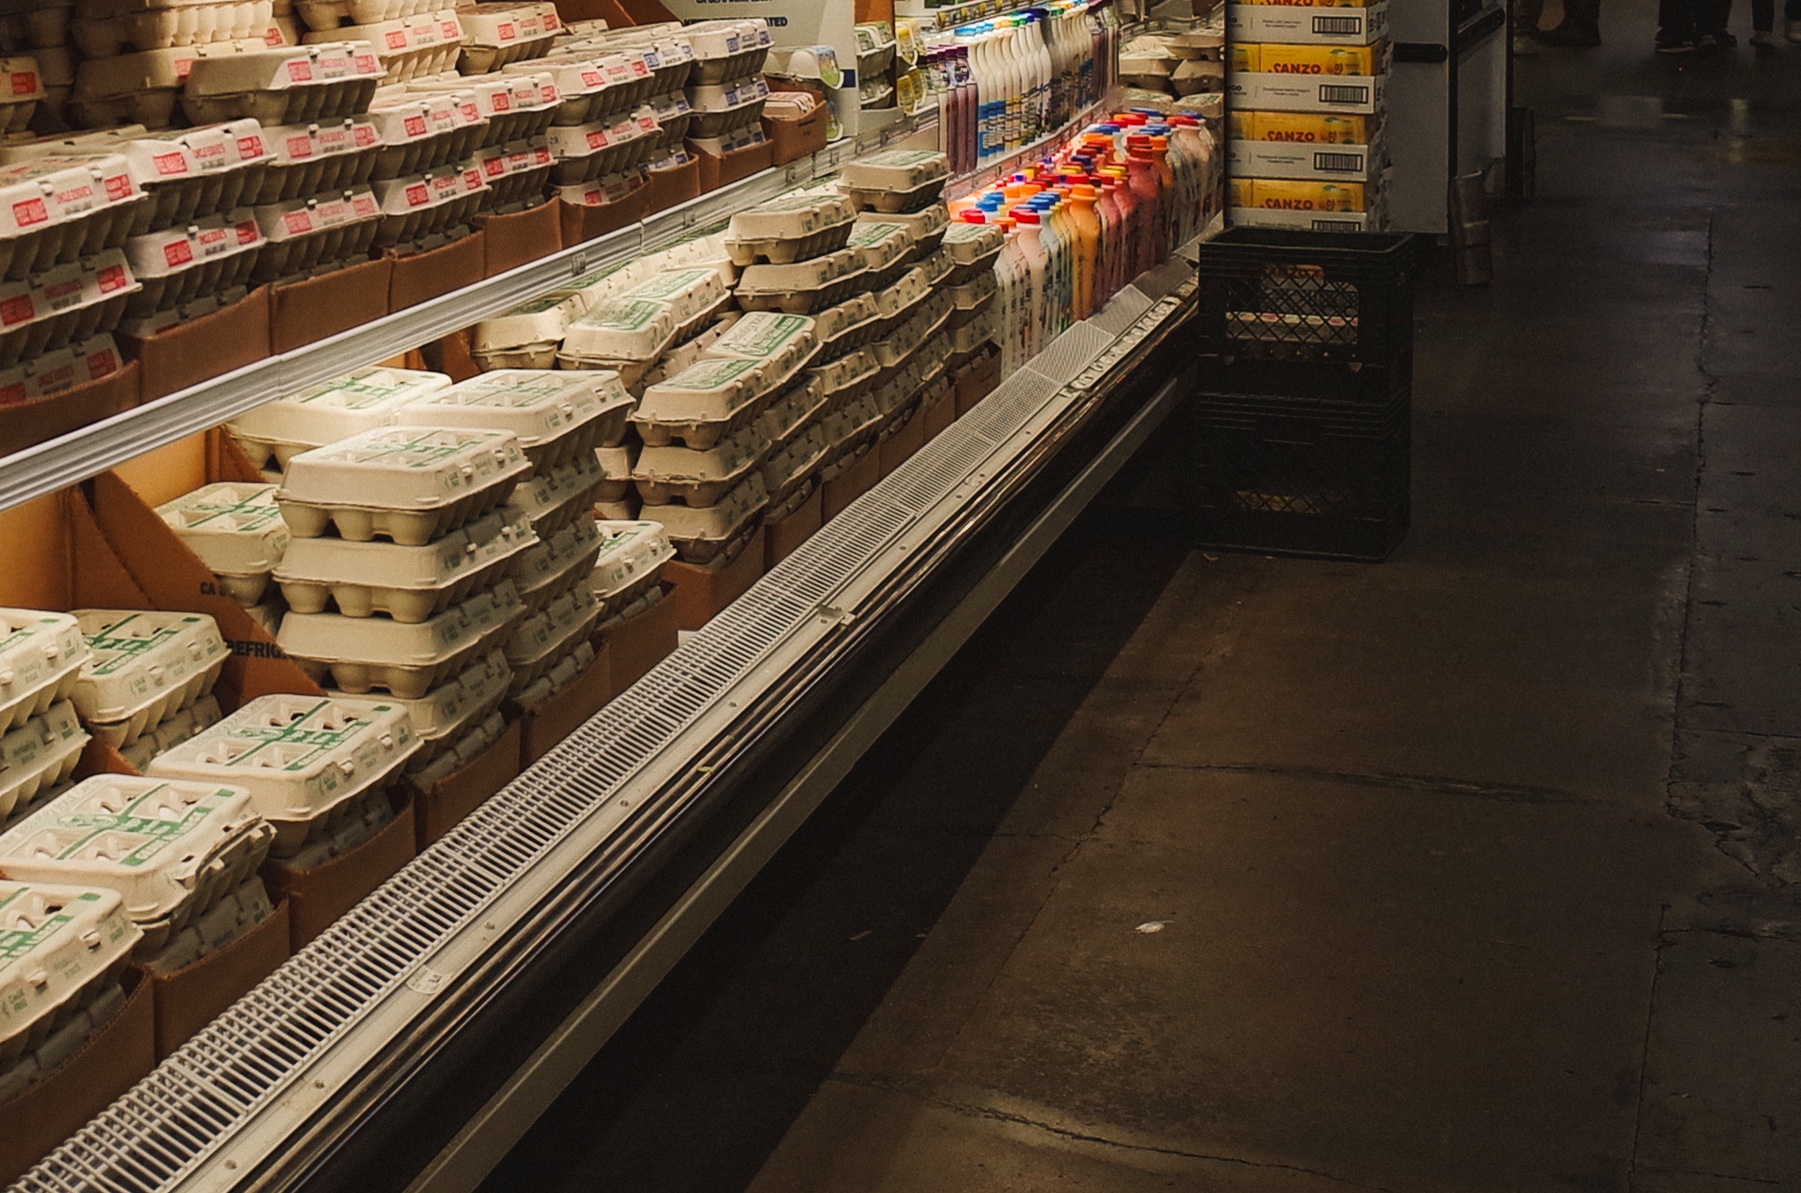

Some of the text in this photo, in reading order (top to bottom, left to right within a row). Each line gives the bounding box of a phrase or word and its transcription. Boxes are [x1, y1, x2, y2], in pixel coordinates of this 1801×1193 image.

[1272, 62, 1322, 75] SANZO
[1266, 130, 1316, 143] SANZO
[1264, 197, 1314, 211] SANZO
[226, 639, 284, 661] REFRIG
